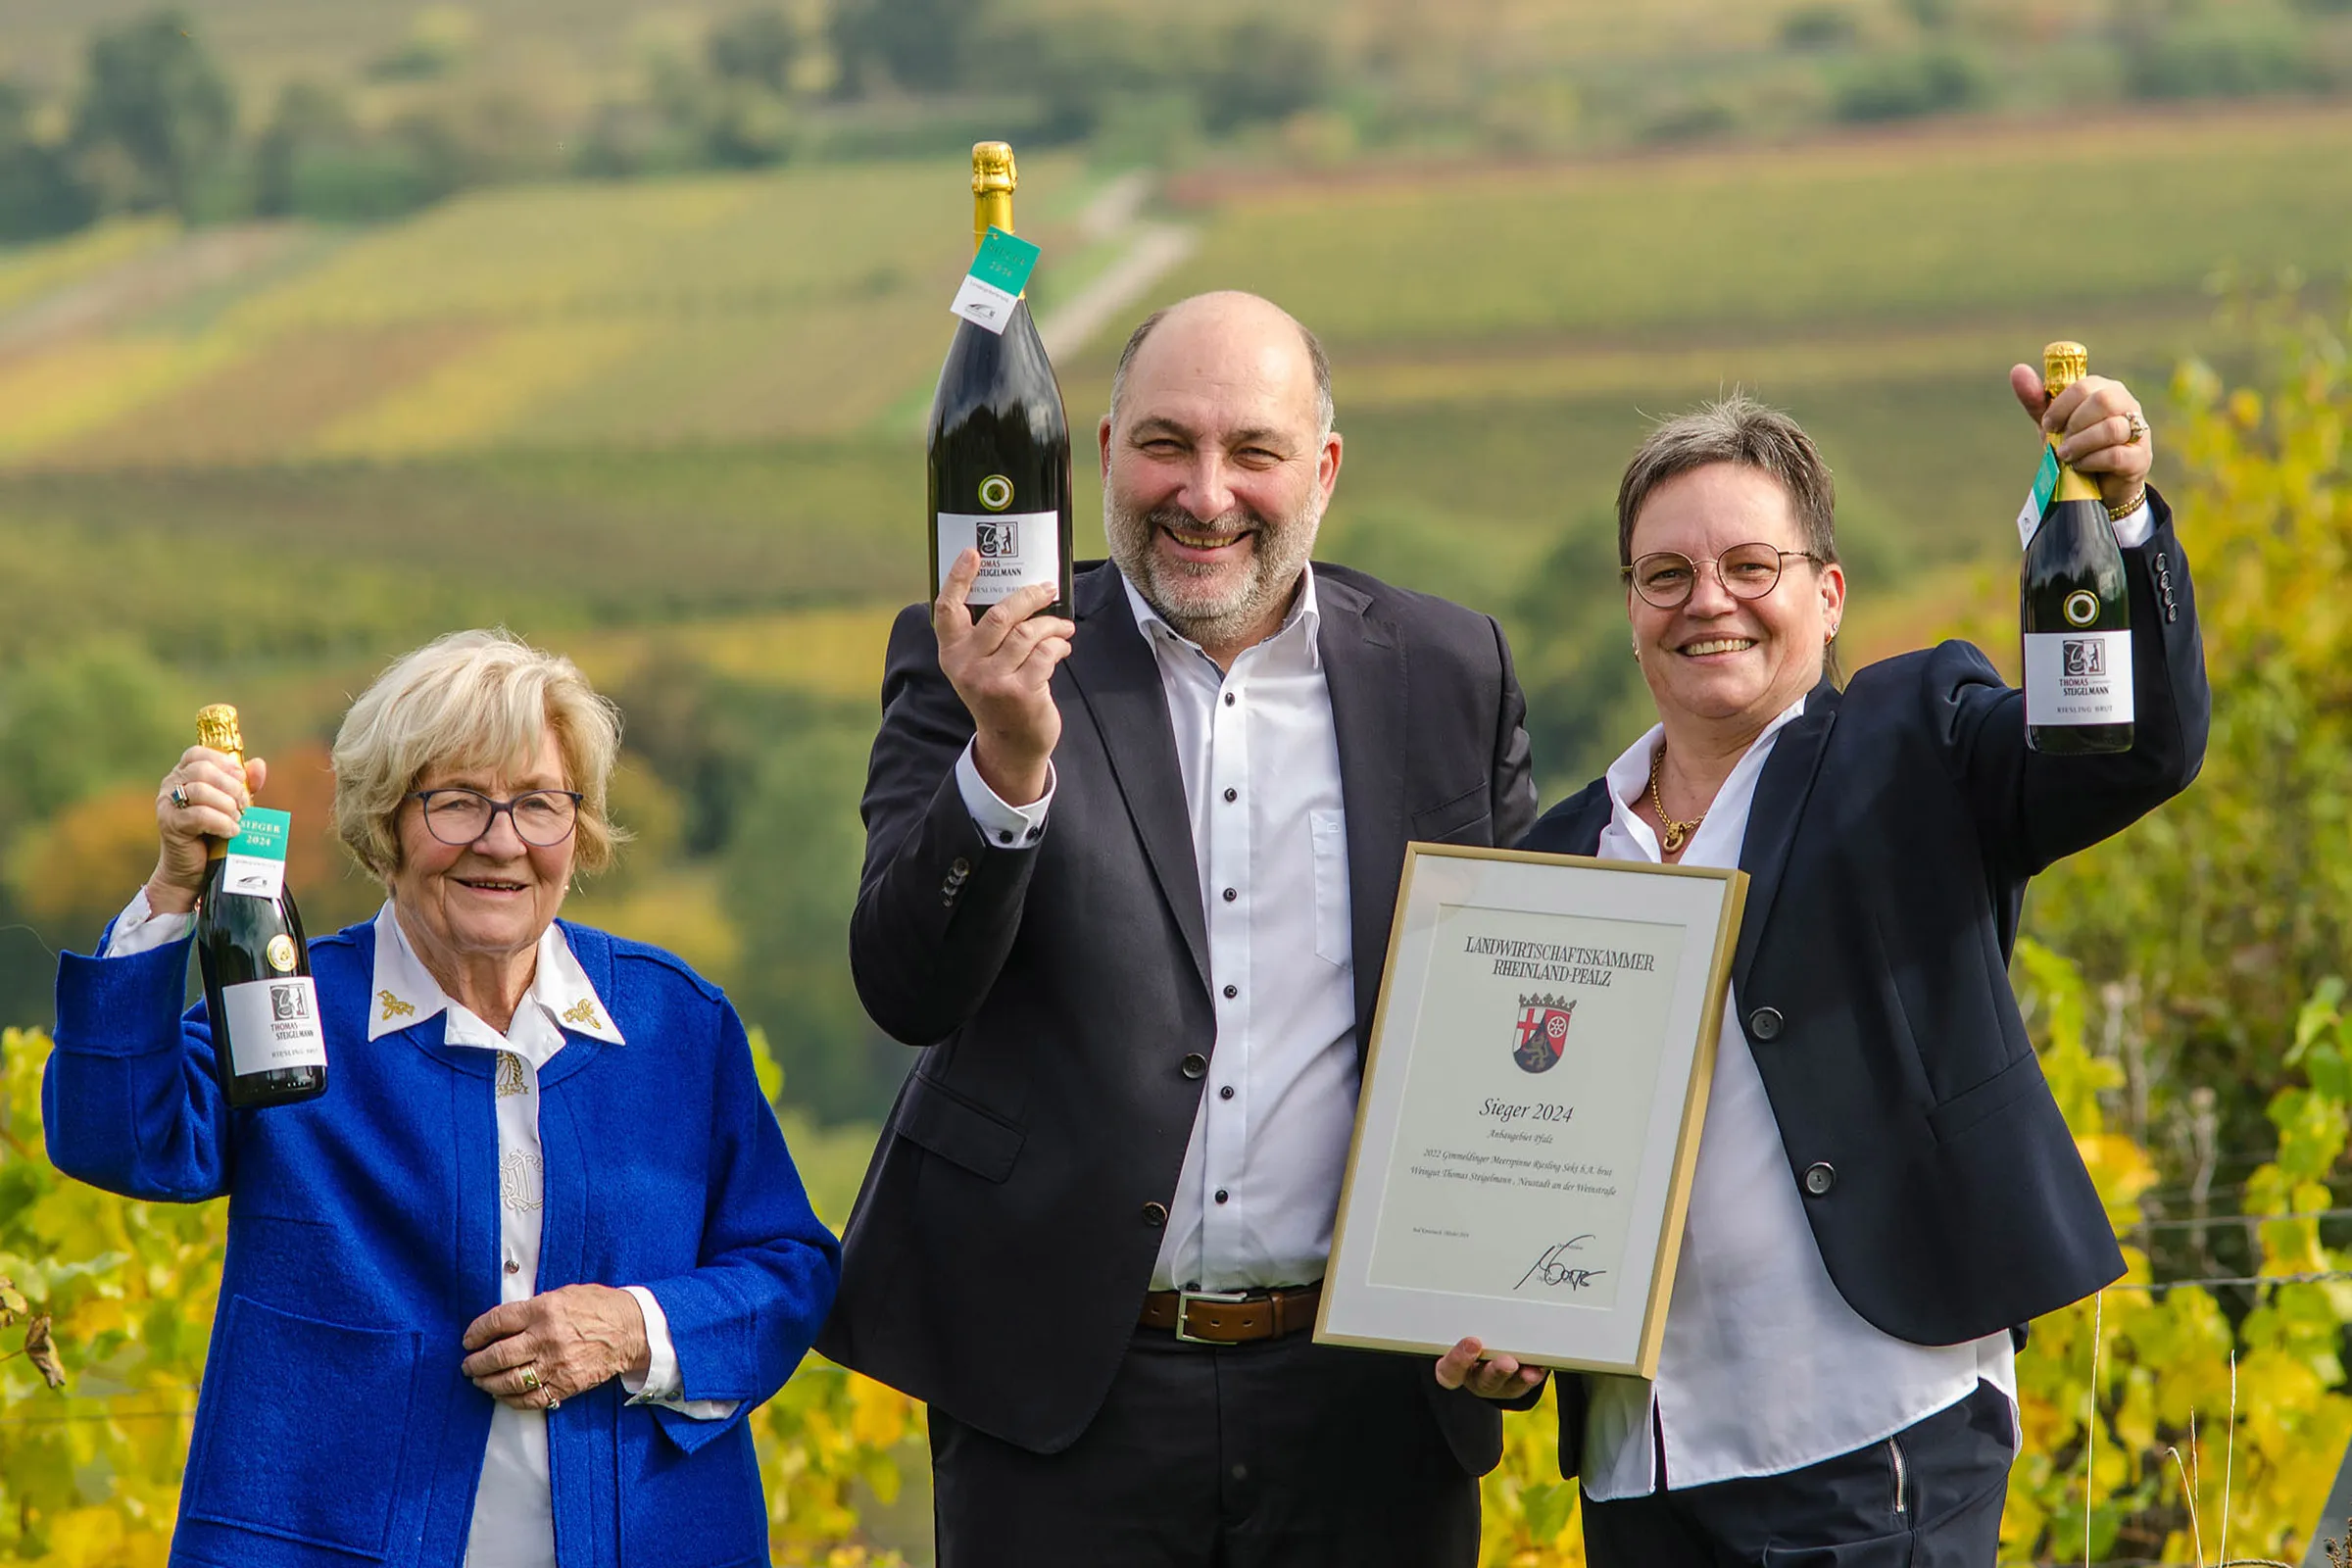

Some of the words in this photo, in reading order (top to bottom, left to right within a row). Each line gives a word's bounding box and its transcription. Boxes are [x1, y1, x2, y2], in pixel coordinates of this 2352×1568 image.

[2059, 678, 2089, 687] THOMAS
[2063, 686, 2109, 697] STEIGELMANN
[2057, 706, 2092, 714] RIESLING
[240, 819, 280, 834] SIEGER
[247, 834, 271, 847] 2024
[1464, 936, 1654, 971] LANDWIRTSCHAFTSKAMMER
[1493, 959, 1612, 987] RHEINLAND-PFALZ
[270, 1022, 299, 1032] THOMAS
[275, 1030, 314, 1041] STEIGELMANN
[1479, 1098, 1531, 1123] Sieger
[1532, 1102, 1574, 1123] 2024
[1424, 1148, 1442, 1158] 2022
[1533, 1159, 1561, 1174] Riesling
[1562, 1162, 1579, 1175] Sekt
[1596, 1165, 1613, 1177] brut
[1410, 1165, 1441, 1179] Weingut
[1442, 1168, 1468, 1180] Thomas
[1517, 1177, 1550, 1189] Neustadt
[1562, 1181, 1576, 1191] der
